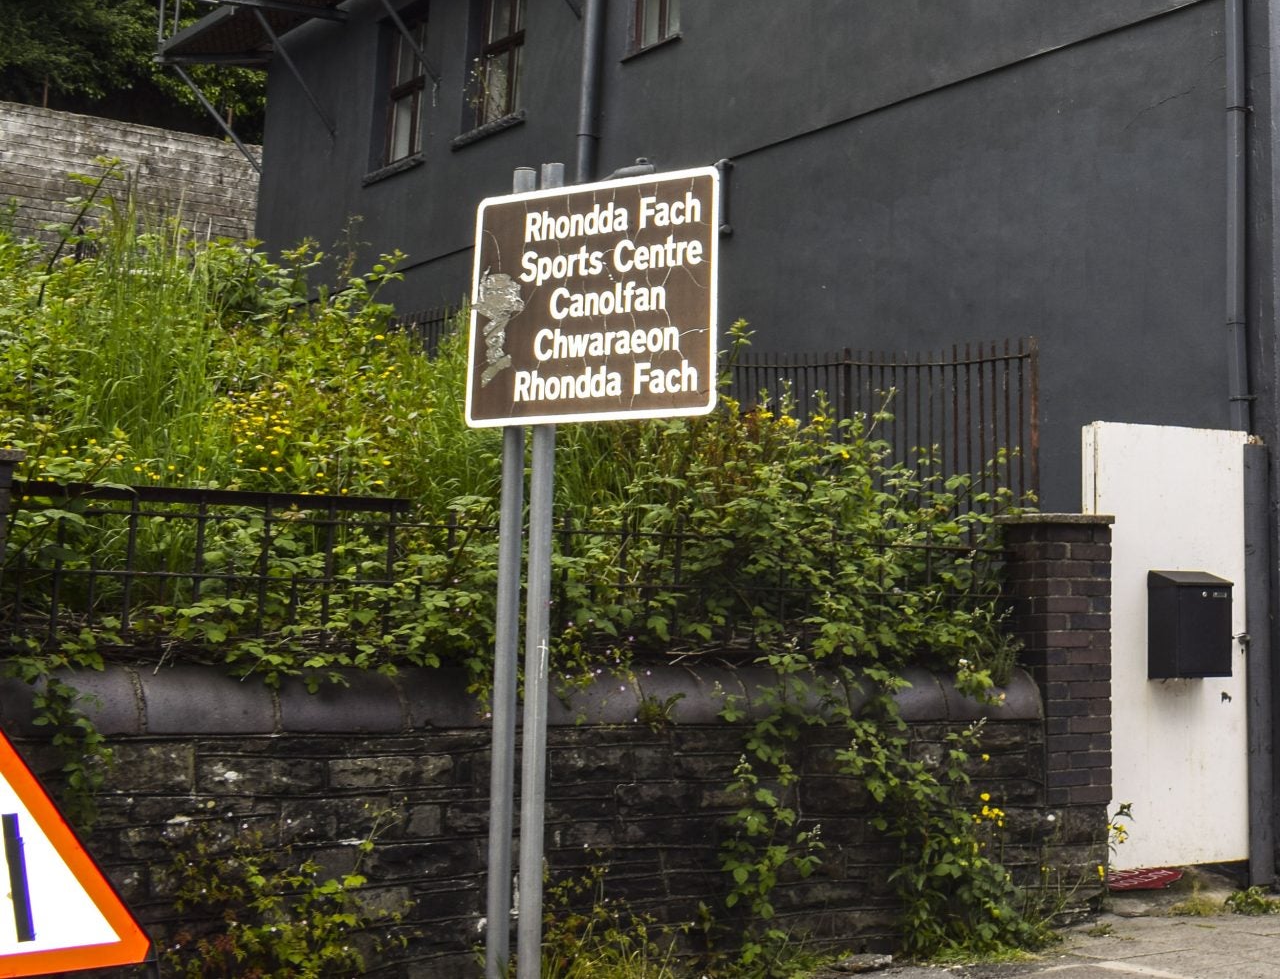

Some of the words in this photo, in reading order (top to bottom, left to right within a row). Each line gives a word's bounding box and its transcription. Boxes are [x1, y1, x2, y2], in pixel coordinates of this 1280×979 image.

[524, 202, 628, 243] Rhondda
[640, 192, 701, 229] Fach
[520, 245, 604, 286] Sports
[613, 235, 703, 273] Centre
[550, 281, 666, 320] Canolfan
[534, 326, 680, 362] Chwaraeon
[514, 366, 622, 402] Rhondda
[633, 359, 698, 395] Fach
